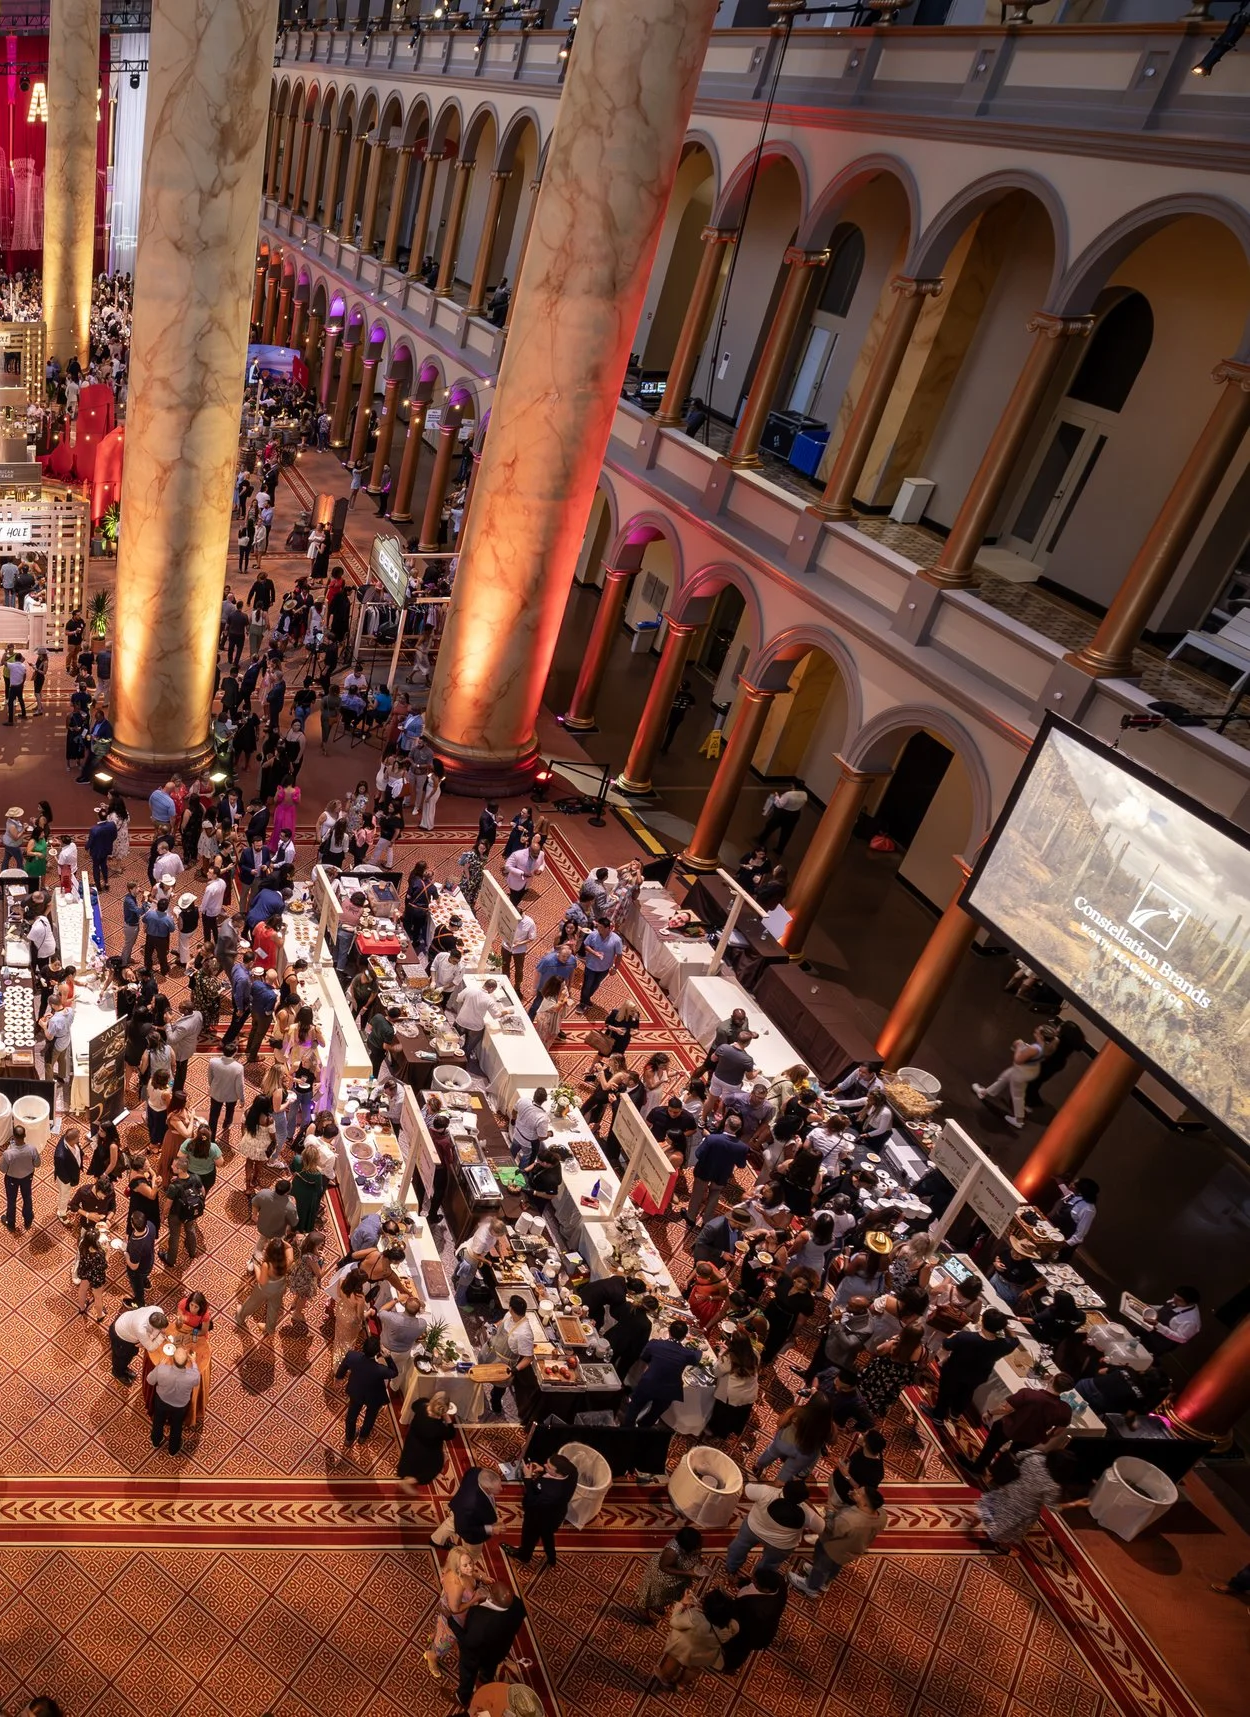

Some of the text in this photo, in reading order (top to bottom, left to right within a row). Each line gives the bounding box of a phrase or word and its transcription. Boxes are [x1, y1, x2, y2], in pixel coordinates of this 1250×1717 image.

[7, 527, 28, 538] HOLE
[1074, 896, 1211, 1009] Constellation Brands
[1080, 922, 1185, 1009] WORTH REACHING FOR
